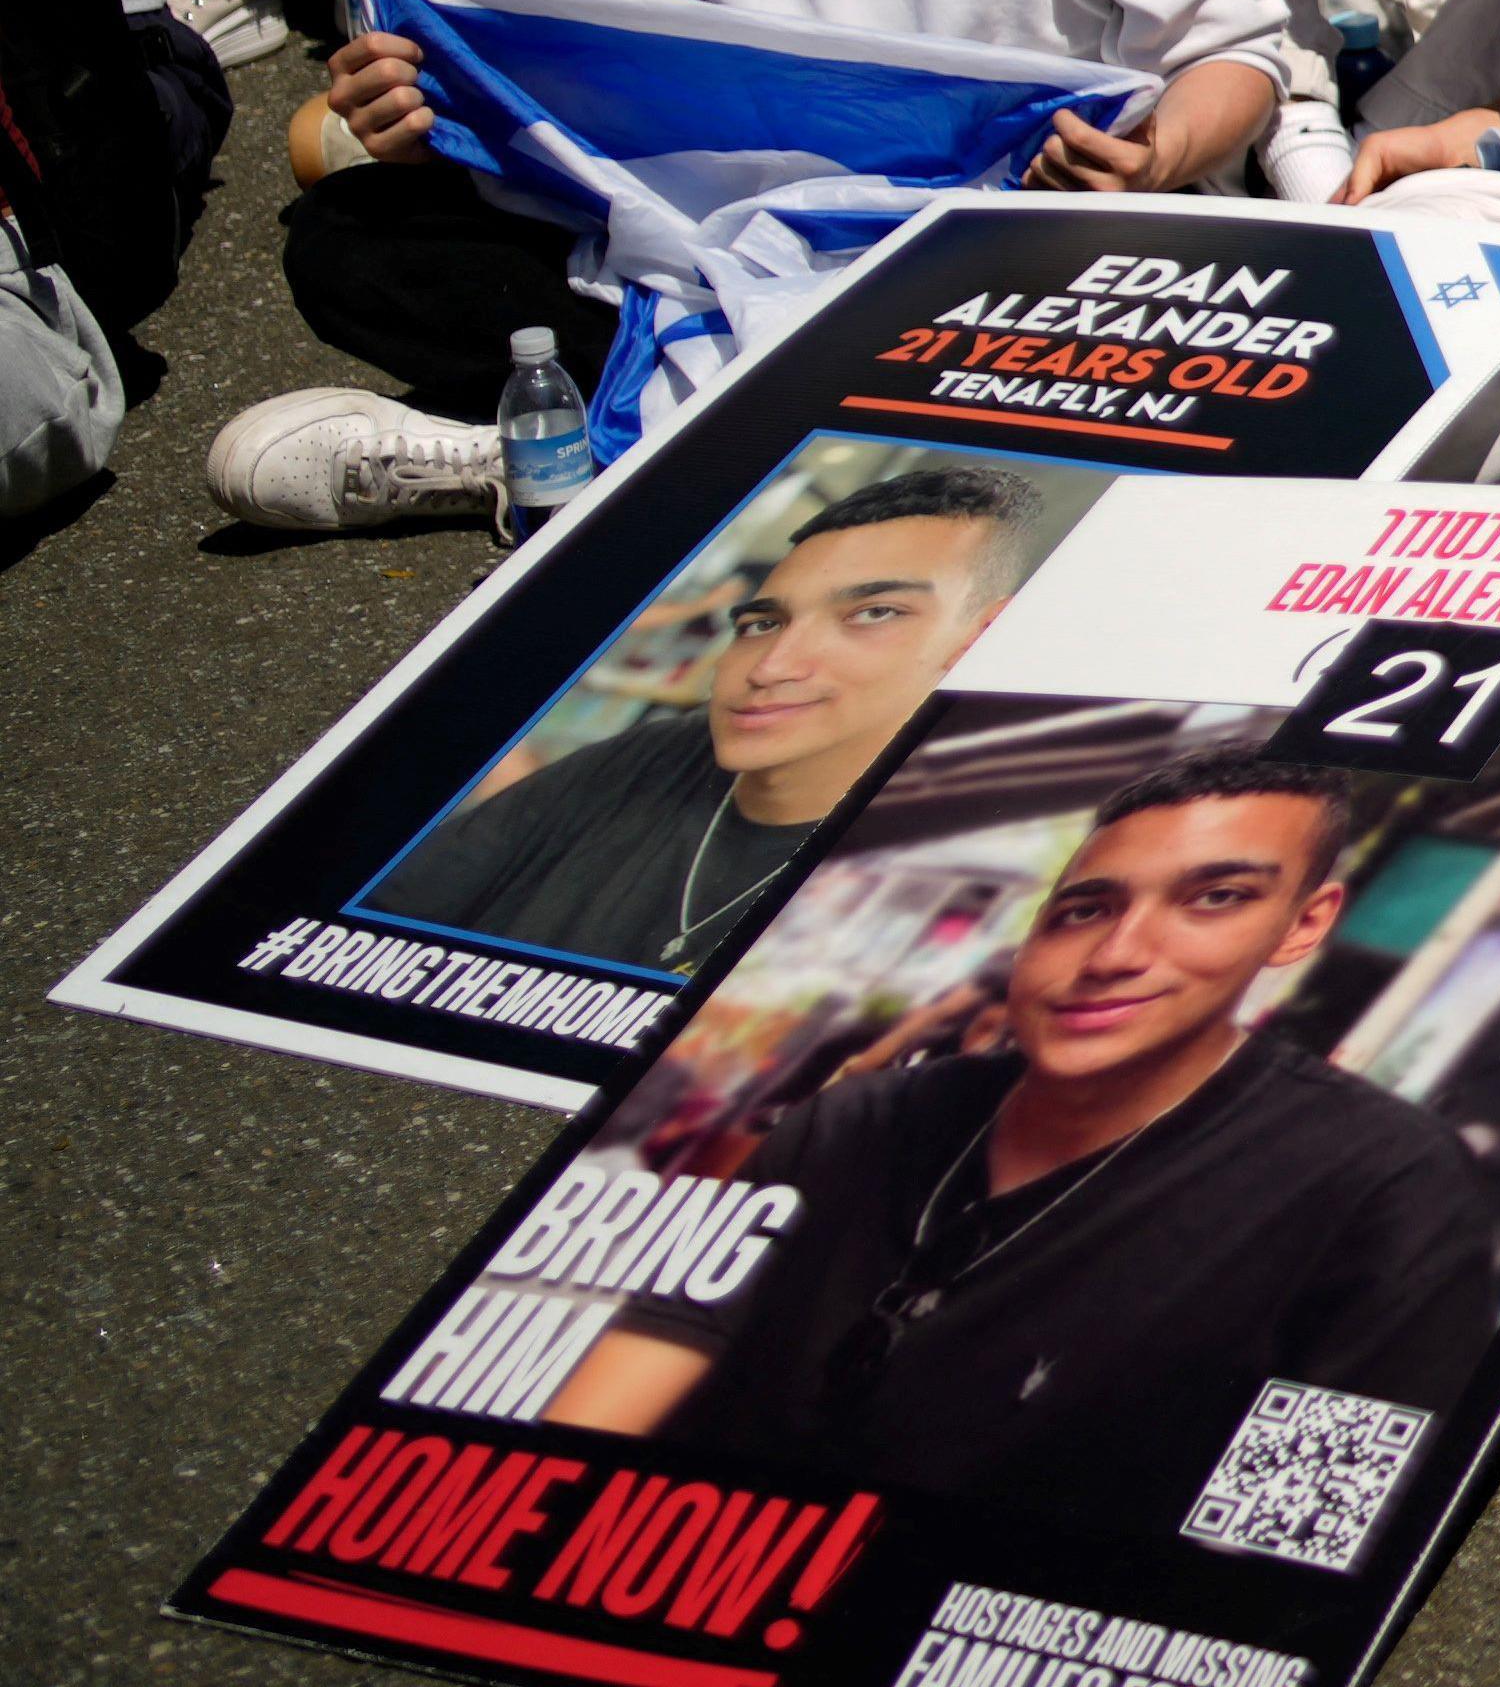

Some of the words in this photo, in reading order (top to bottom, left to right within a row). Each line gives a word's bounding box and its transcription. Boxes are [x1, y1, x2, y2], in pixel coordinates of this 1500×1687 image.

[1066, 254, 1293, 308] EDAN
[933, 291, 1336, 360] ALEXANDER
[875, 328, 958, 363] 21
[960, 331, 1165, 384] YEARS
[1168, 355, 1309, 400] OLD
[930, 370, 1120, 418] TENAFLY,
[1126, 391, 1200, 422] NJ
[556, 438, 588, 459] SPRIN
[1265, 563, 1413, 616] EDAN
[238, 917, 677, 1050] #BRINGTHEMHOME
[485, 1166, 802, 1303] BRING
[380, 1288, 620, 1422] HIM
[261, 1425, 587, 1591] HOME
[532, 1470, 882, 1652] NOW!
[931, 1581, 1102, 1659] HOSTAGES
[1085, 1616, 1168, 1672] AND
[1154, 1630, 1310, 1687] MISSING
